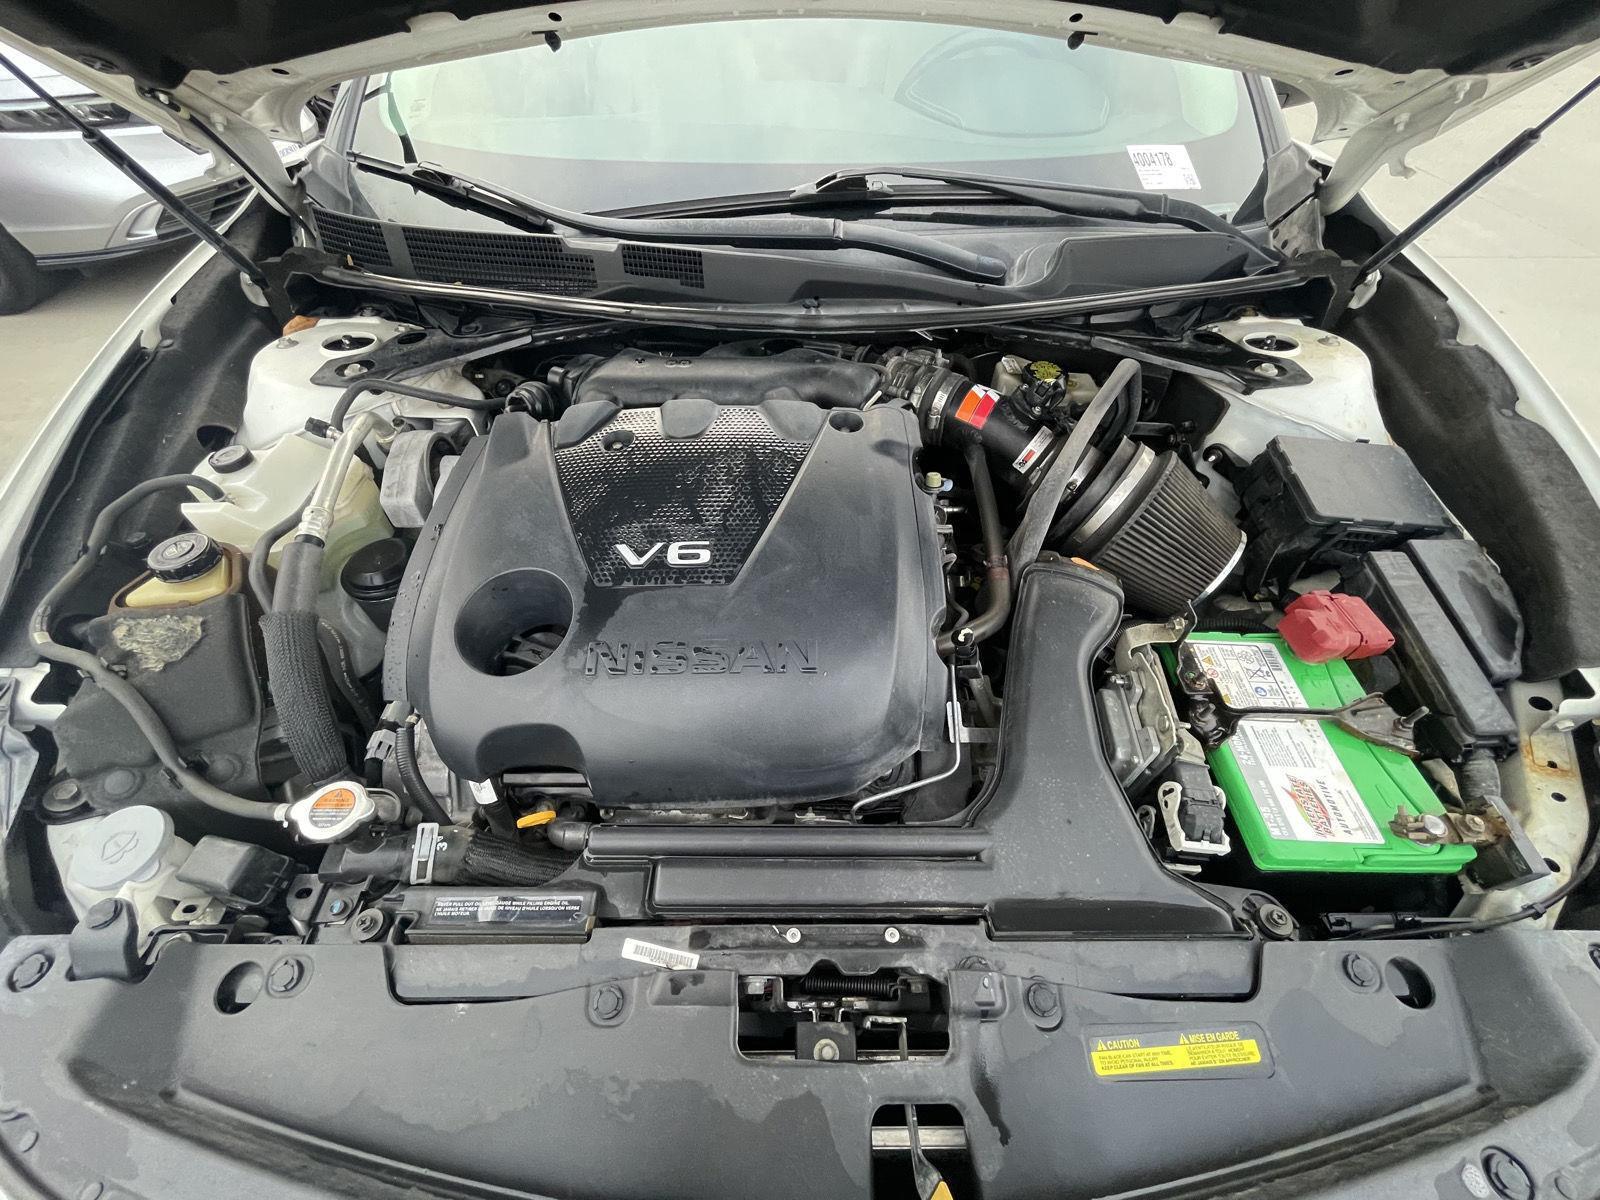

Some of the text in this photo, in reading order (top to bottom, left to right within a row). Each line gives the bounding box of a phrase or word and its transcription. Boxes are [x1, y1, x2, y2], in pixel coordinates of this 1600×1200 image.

[1132, 152, 1173, 167] 4004178
[614, 541, 711, 569] V6
[585, 639, 818, 676] NISSAN
[1289, 775, 1327, 838] INTERSTATE
[1300, 780, 1335, 837] BATTERIES
[1316, 779, 1353, 835] AUTOMOTIVE
[1107, 1038, 1140, 1050] CAUTION
[1188, 1031, 1240, 1044] MISE EN GARDE
